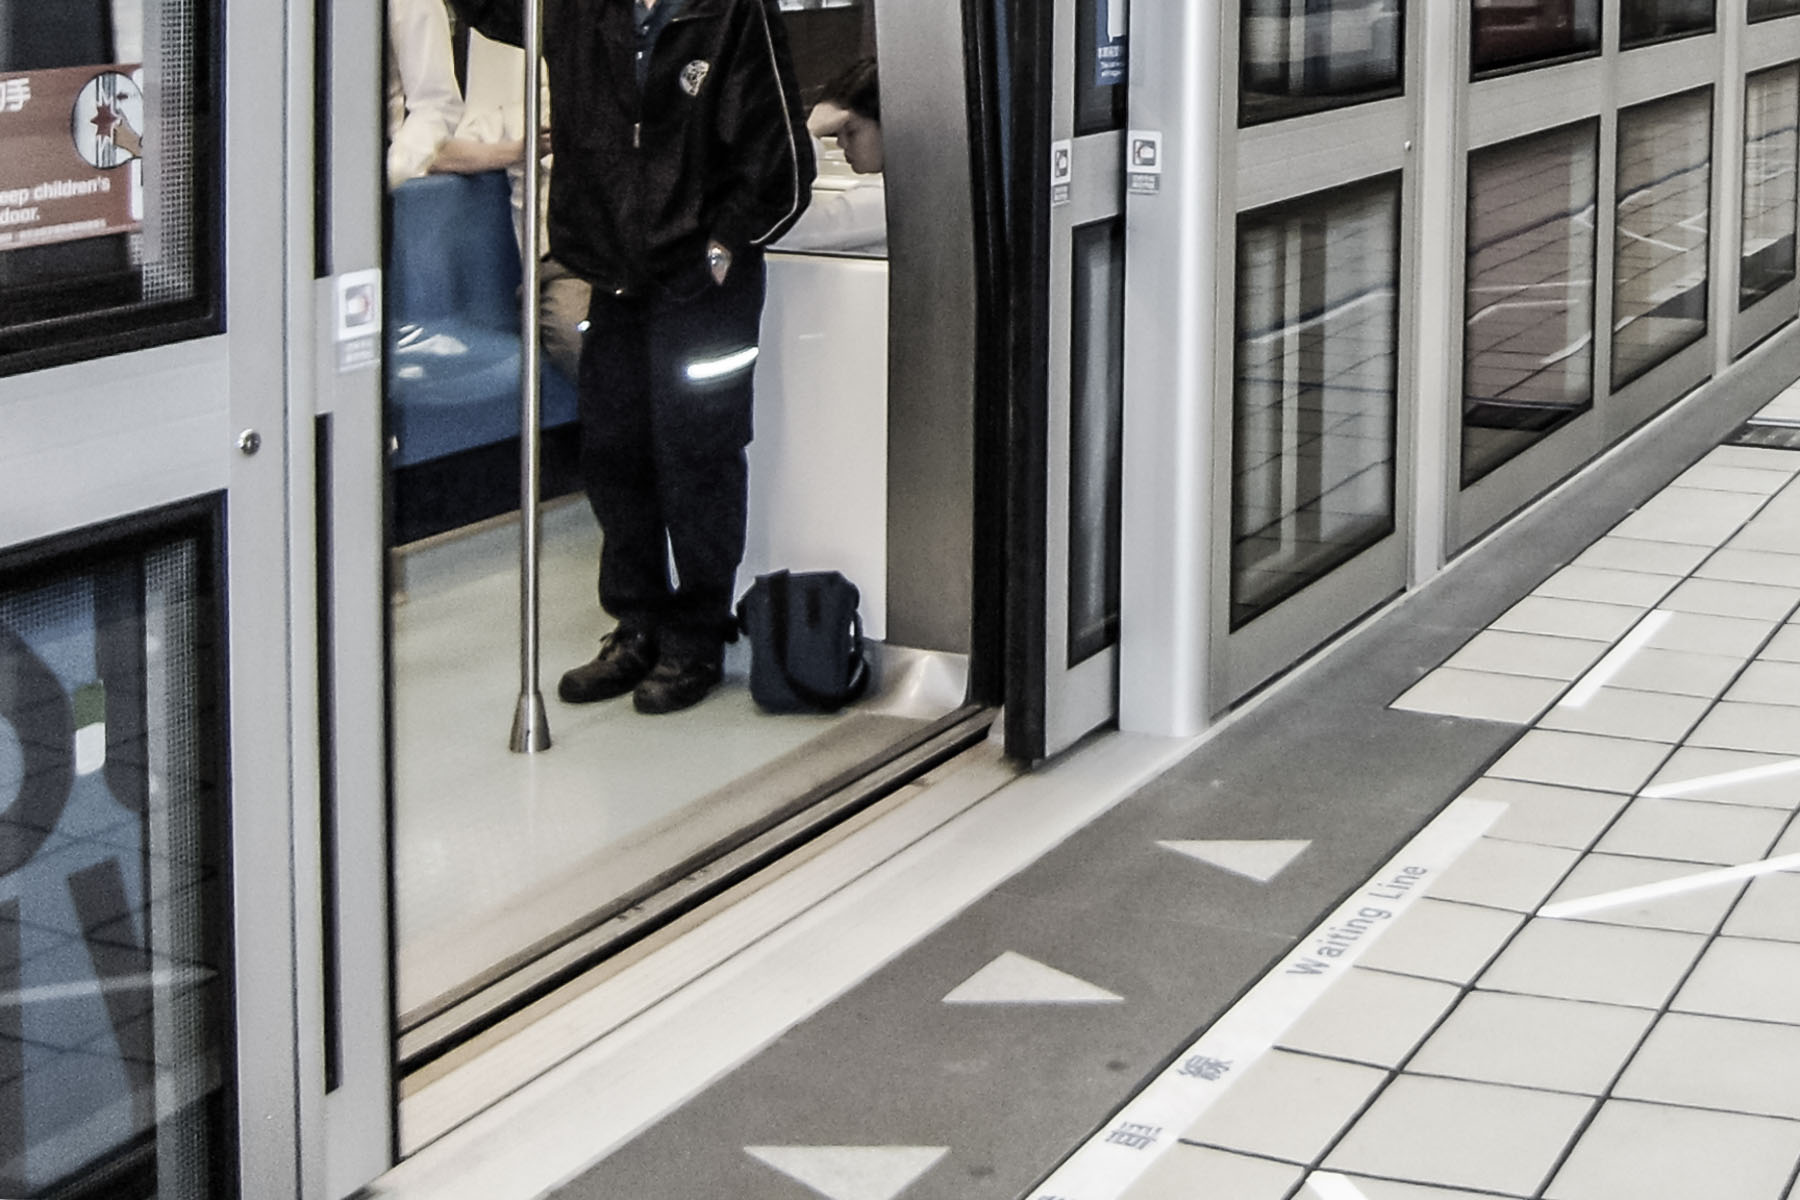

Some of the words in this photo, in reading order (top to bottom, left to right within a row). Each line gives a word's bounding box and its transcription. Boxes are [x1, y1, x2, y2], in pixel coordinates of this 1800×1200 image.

[33, 176, 111, 199] children's
[1285, 906, 1392, 975] Waiting
[1368, 865, 1427, 899] Line
